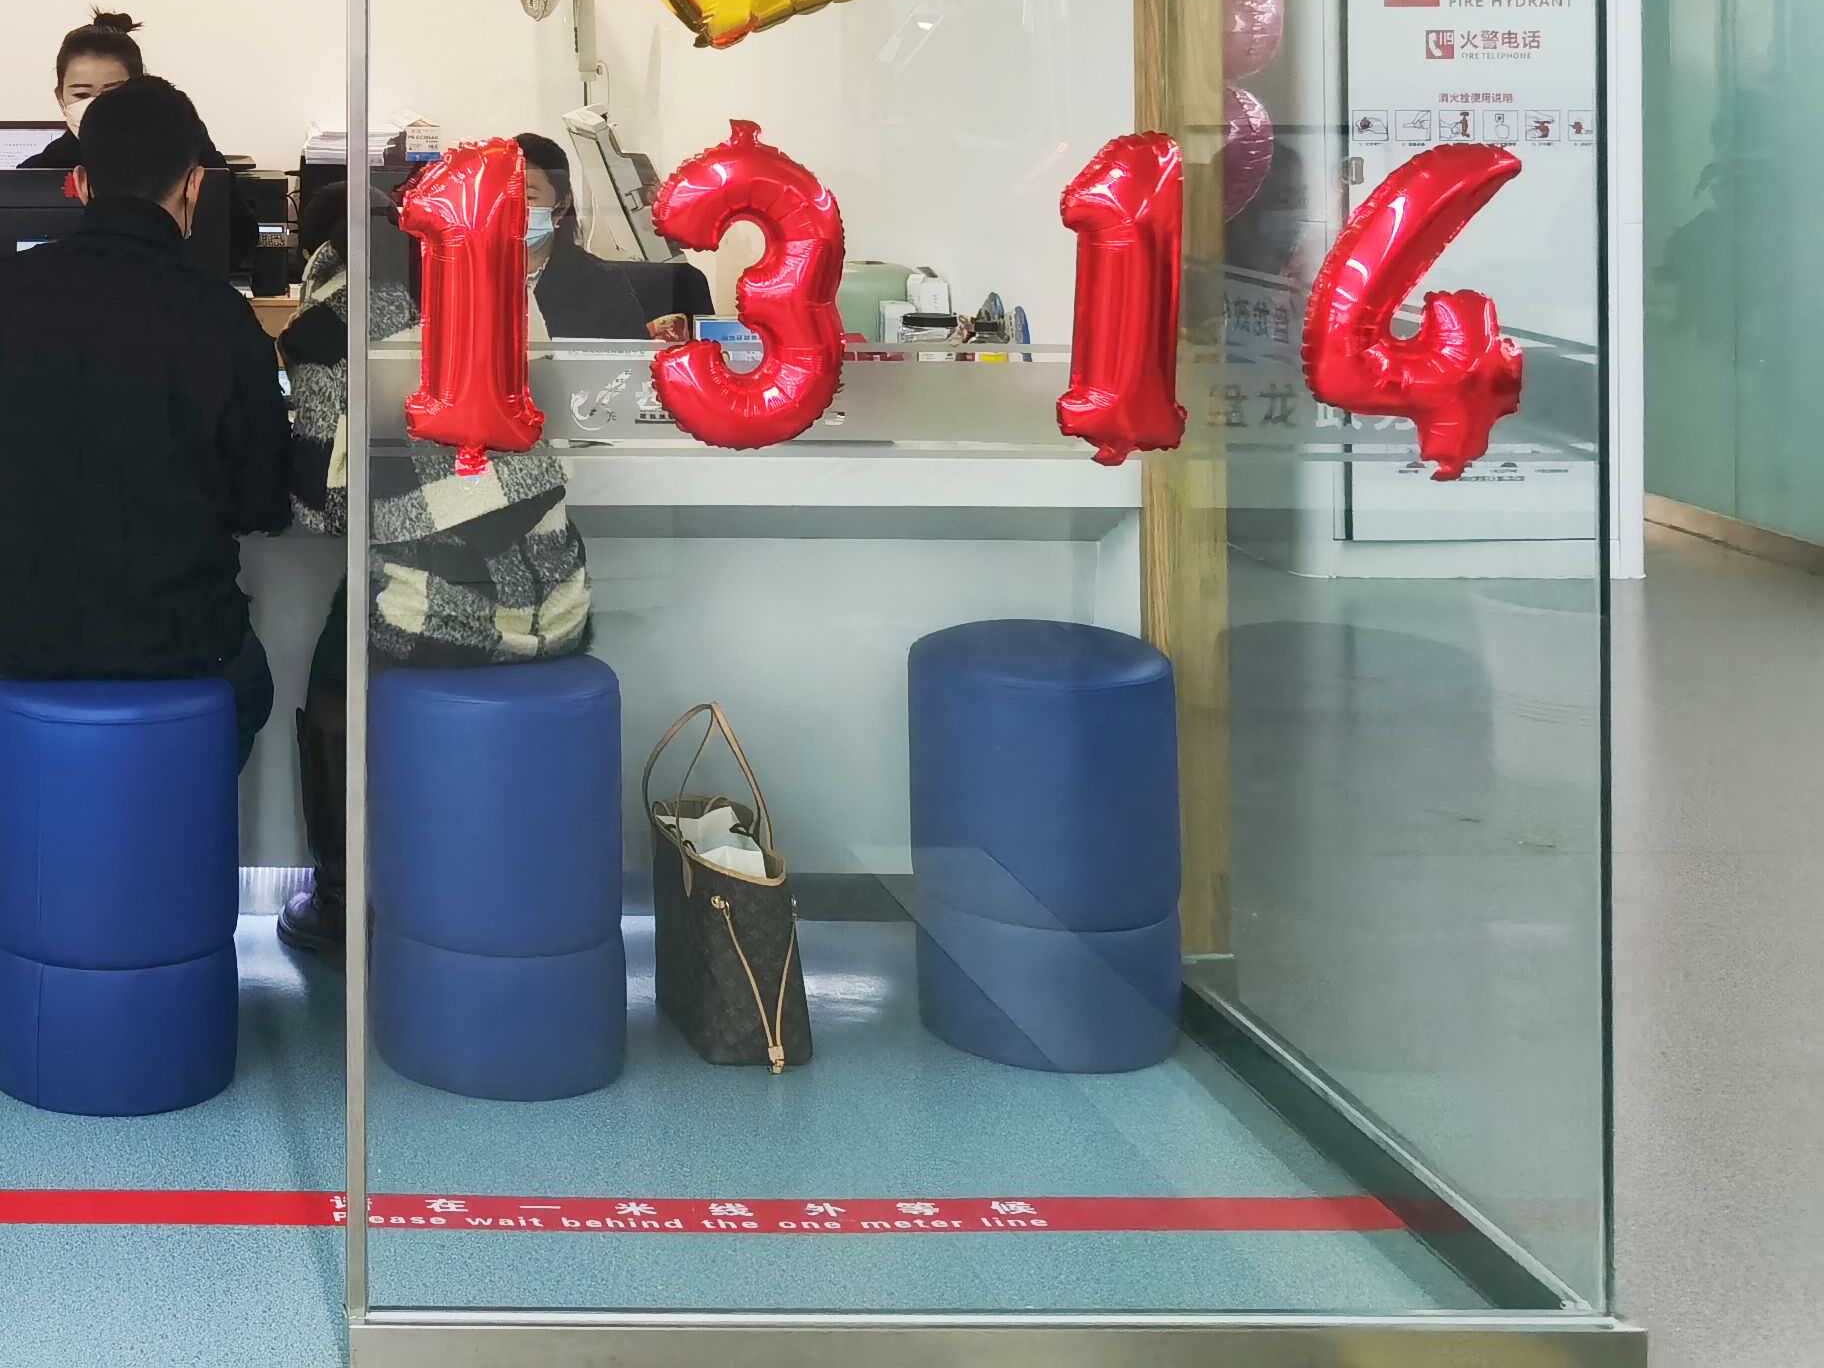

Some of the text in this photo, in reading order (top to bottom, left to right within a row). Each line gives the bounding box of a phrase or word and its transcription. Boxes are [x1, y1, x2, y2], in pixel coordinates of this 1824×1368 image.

[1460, 30, 1541, 50] 火警电话
[1461, 52, 1480, 60] FIRE
[1438, 92, 1514, 104] 消火栓使用说明
[332, 1211, 1049, 1229] Pease wait behind the one meter line
